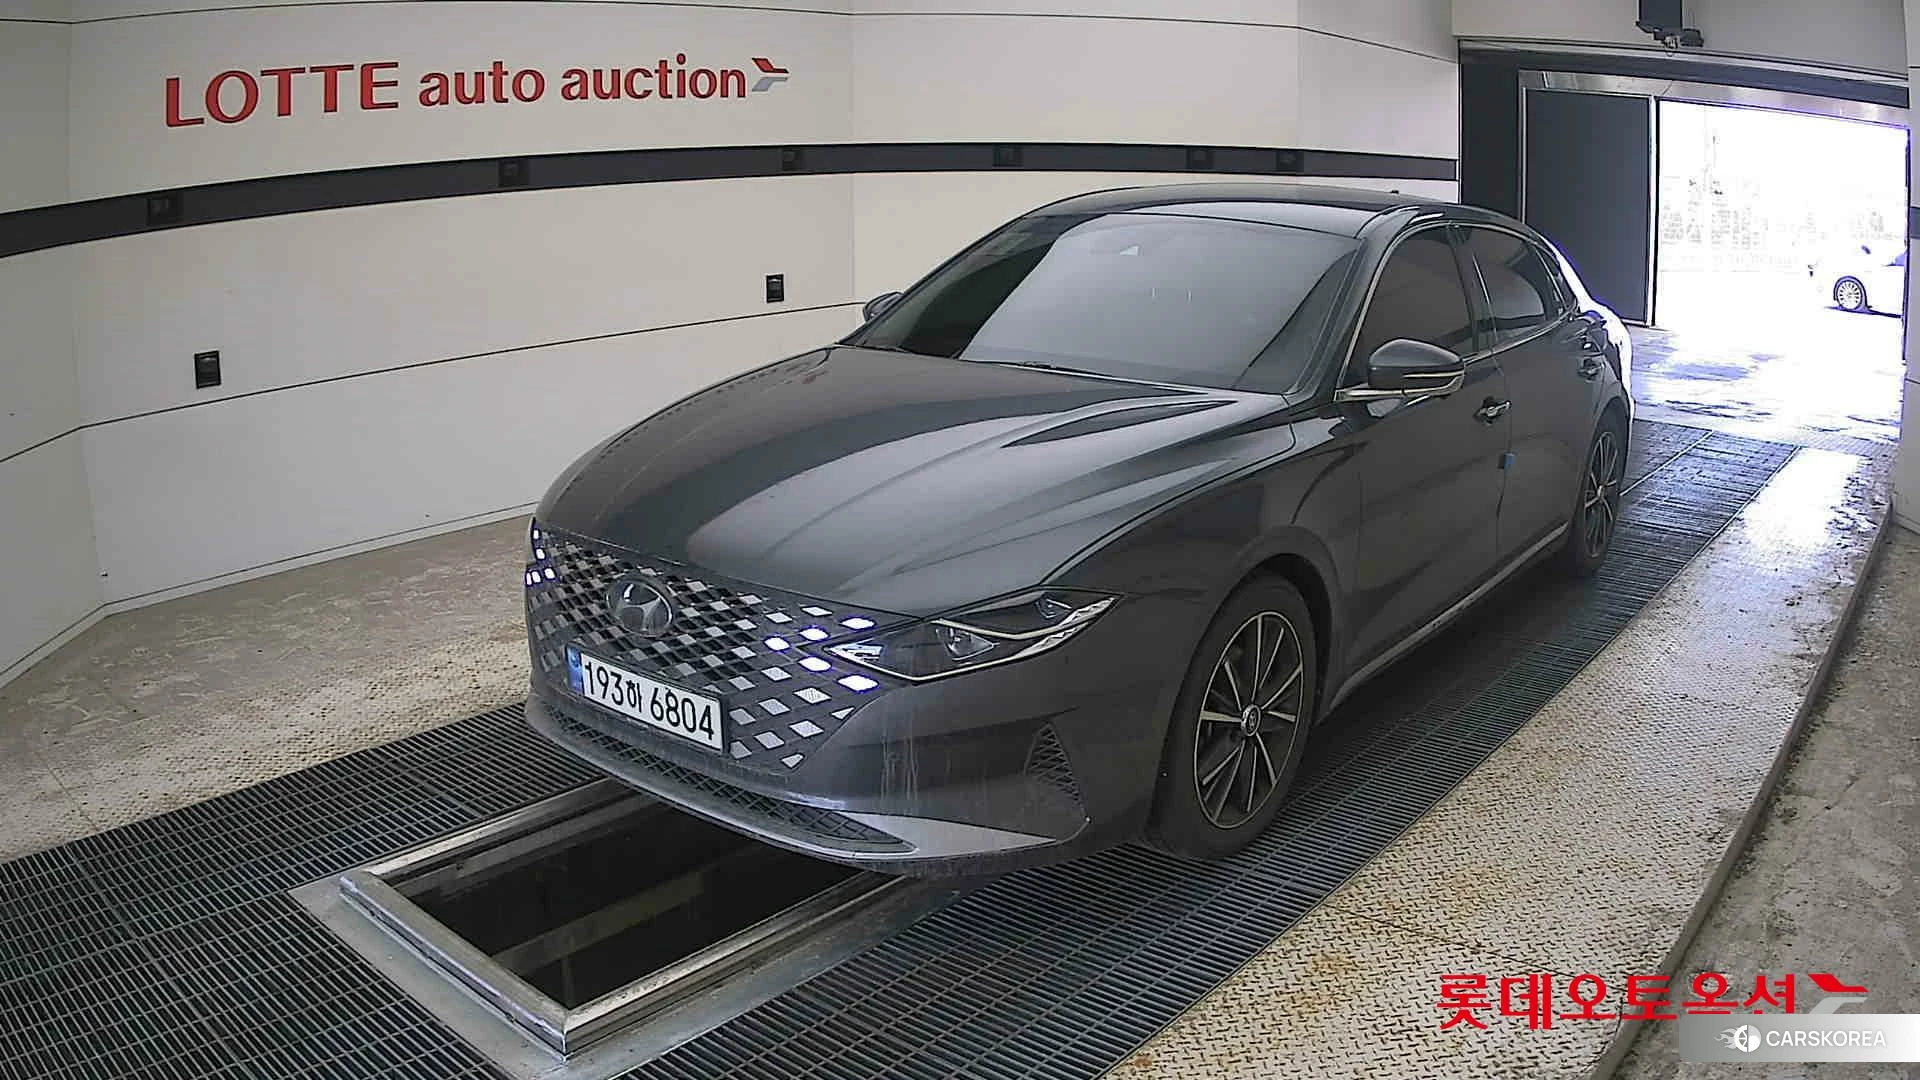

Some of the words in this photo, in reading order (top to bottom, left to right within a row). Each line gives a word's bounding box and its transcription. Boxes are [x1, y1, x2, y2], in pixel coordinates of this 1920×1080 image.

[165, 61, 399, 127] LOTTE
[419, 60, 546, 106] auto
[561, 53, 747, 100] auction
[585, 661, 642, 713] 193하
[650, 687, 715, 741] 6804
